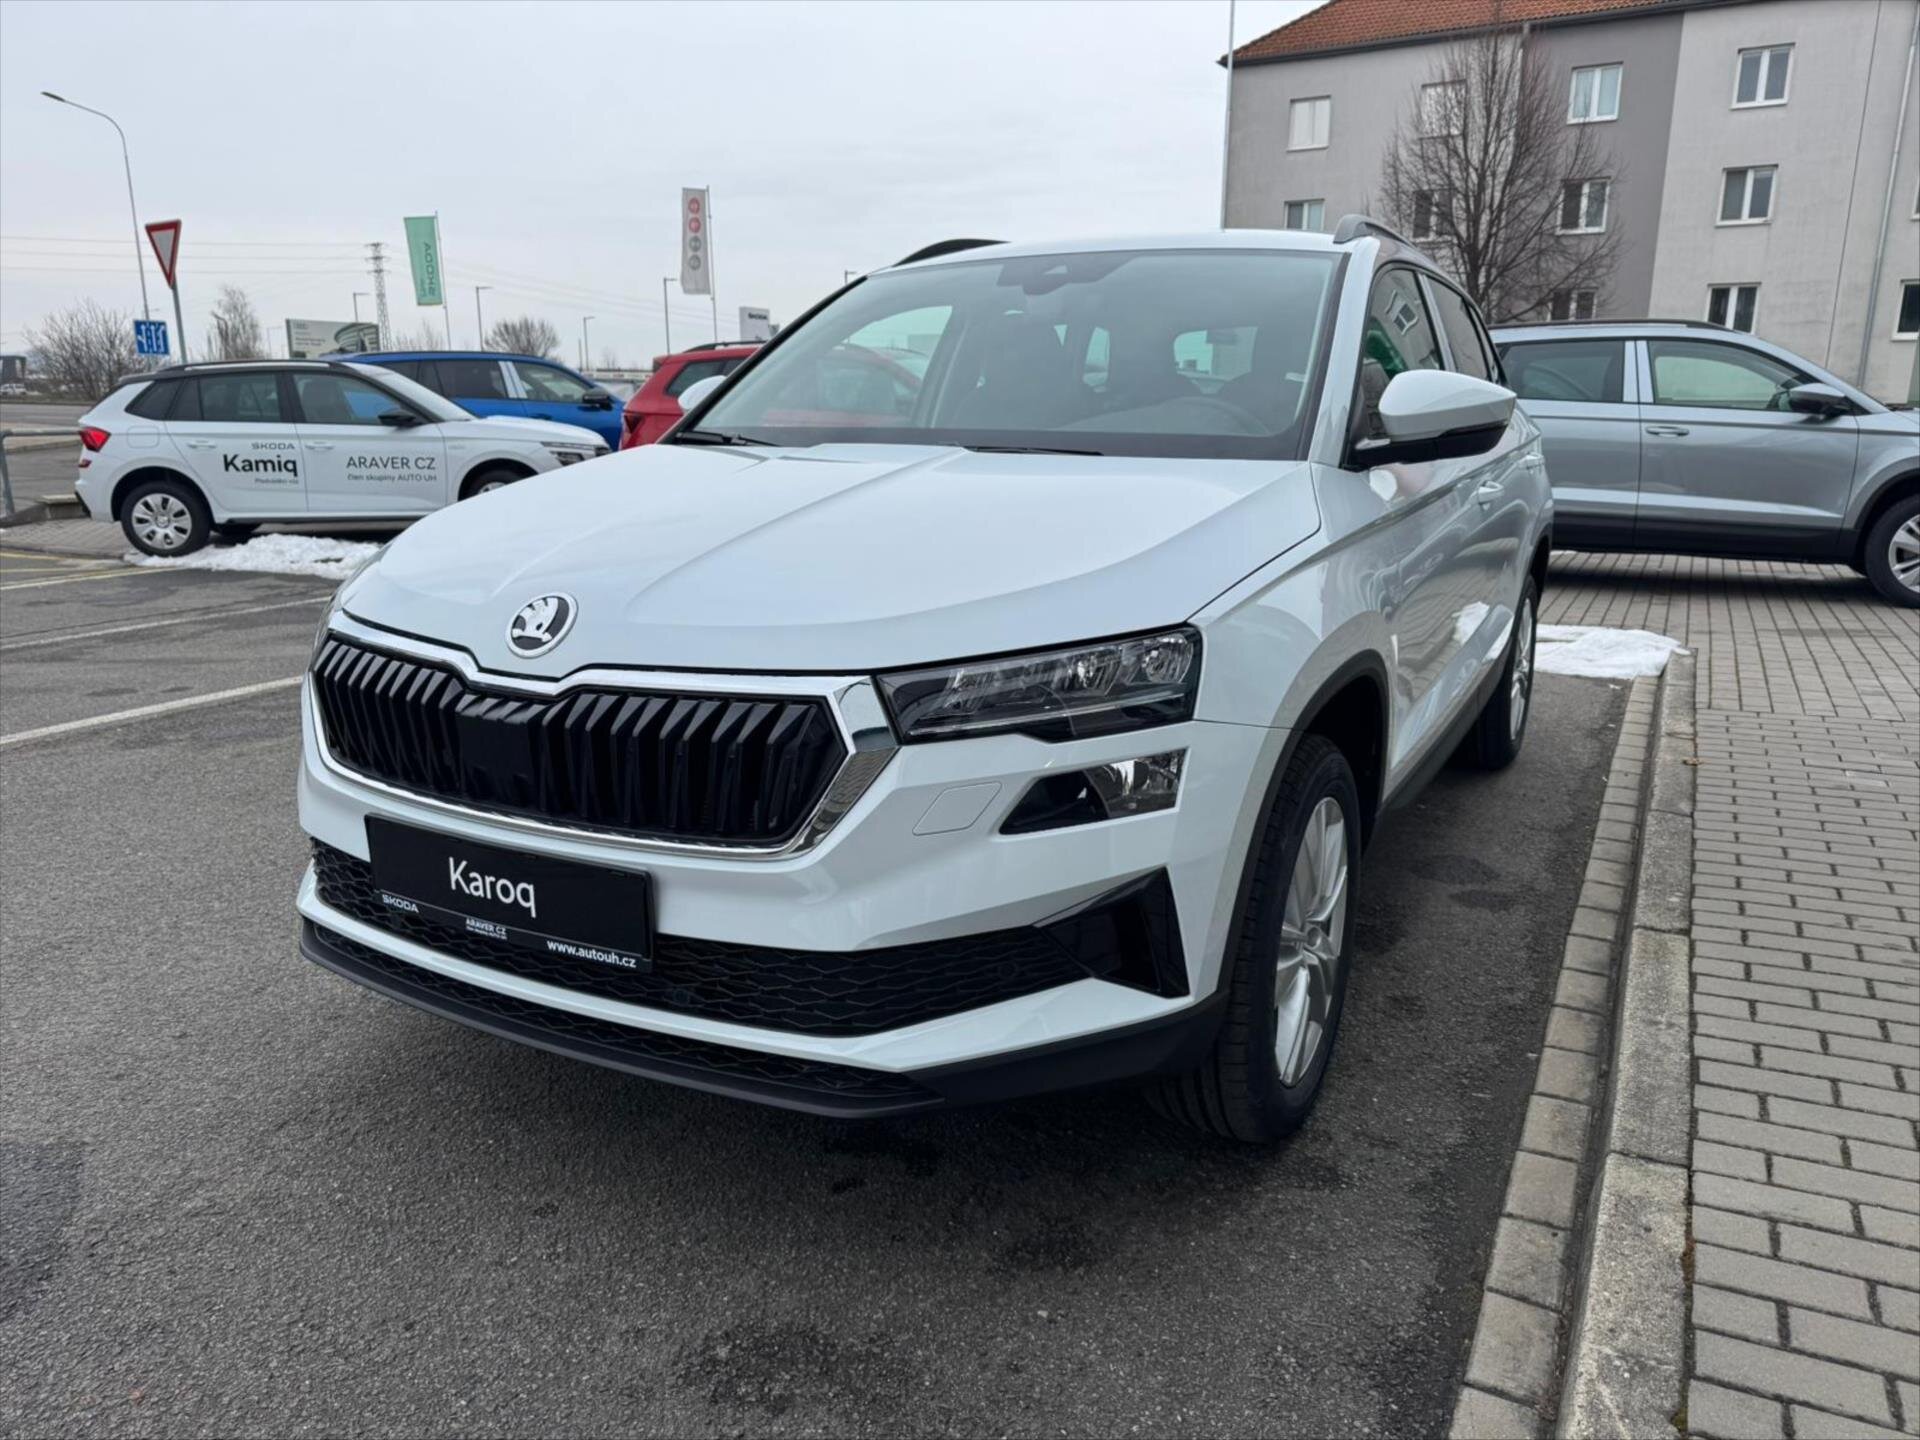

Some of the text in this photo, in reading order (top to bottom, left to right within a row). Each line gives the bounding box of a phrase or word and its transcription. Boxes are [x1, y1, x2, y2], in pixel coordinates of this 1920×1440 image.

[222, 453, 298, 478] Kamiq
[345, 456, 437, 471] ARAVER CZ
[397, 473, 422, 482] AUTO
[448, 856, 537, 918] Karoq
[546, 940, 637, 968] www.autouh.cz
